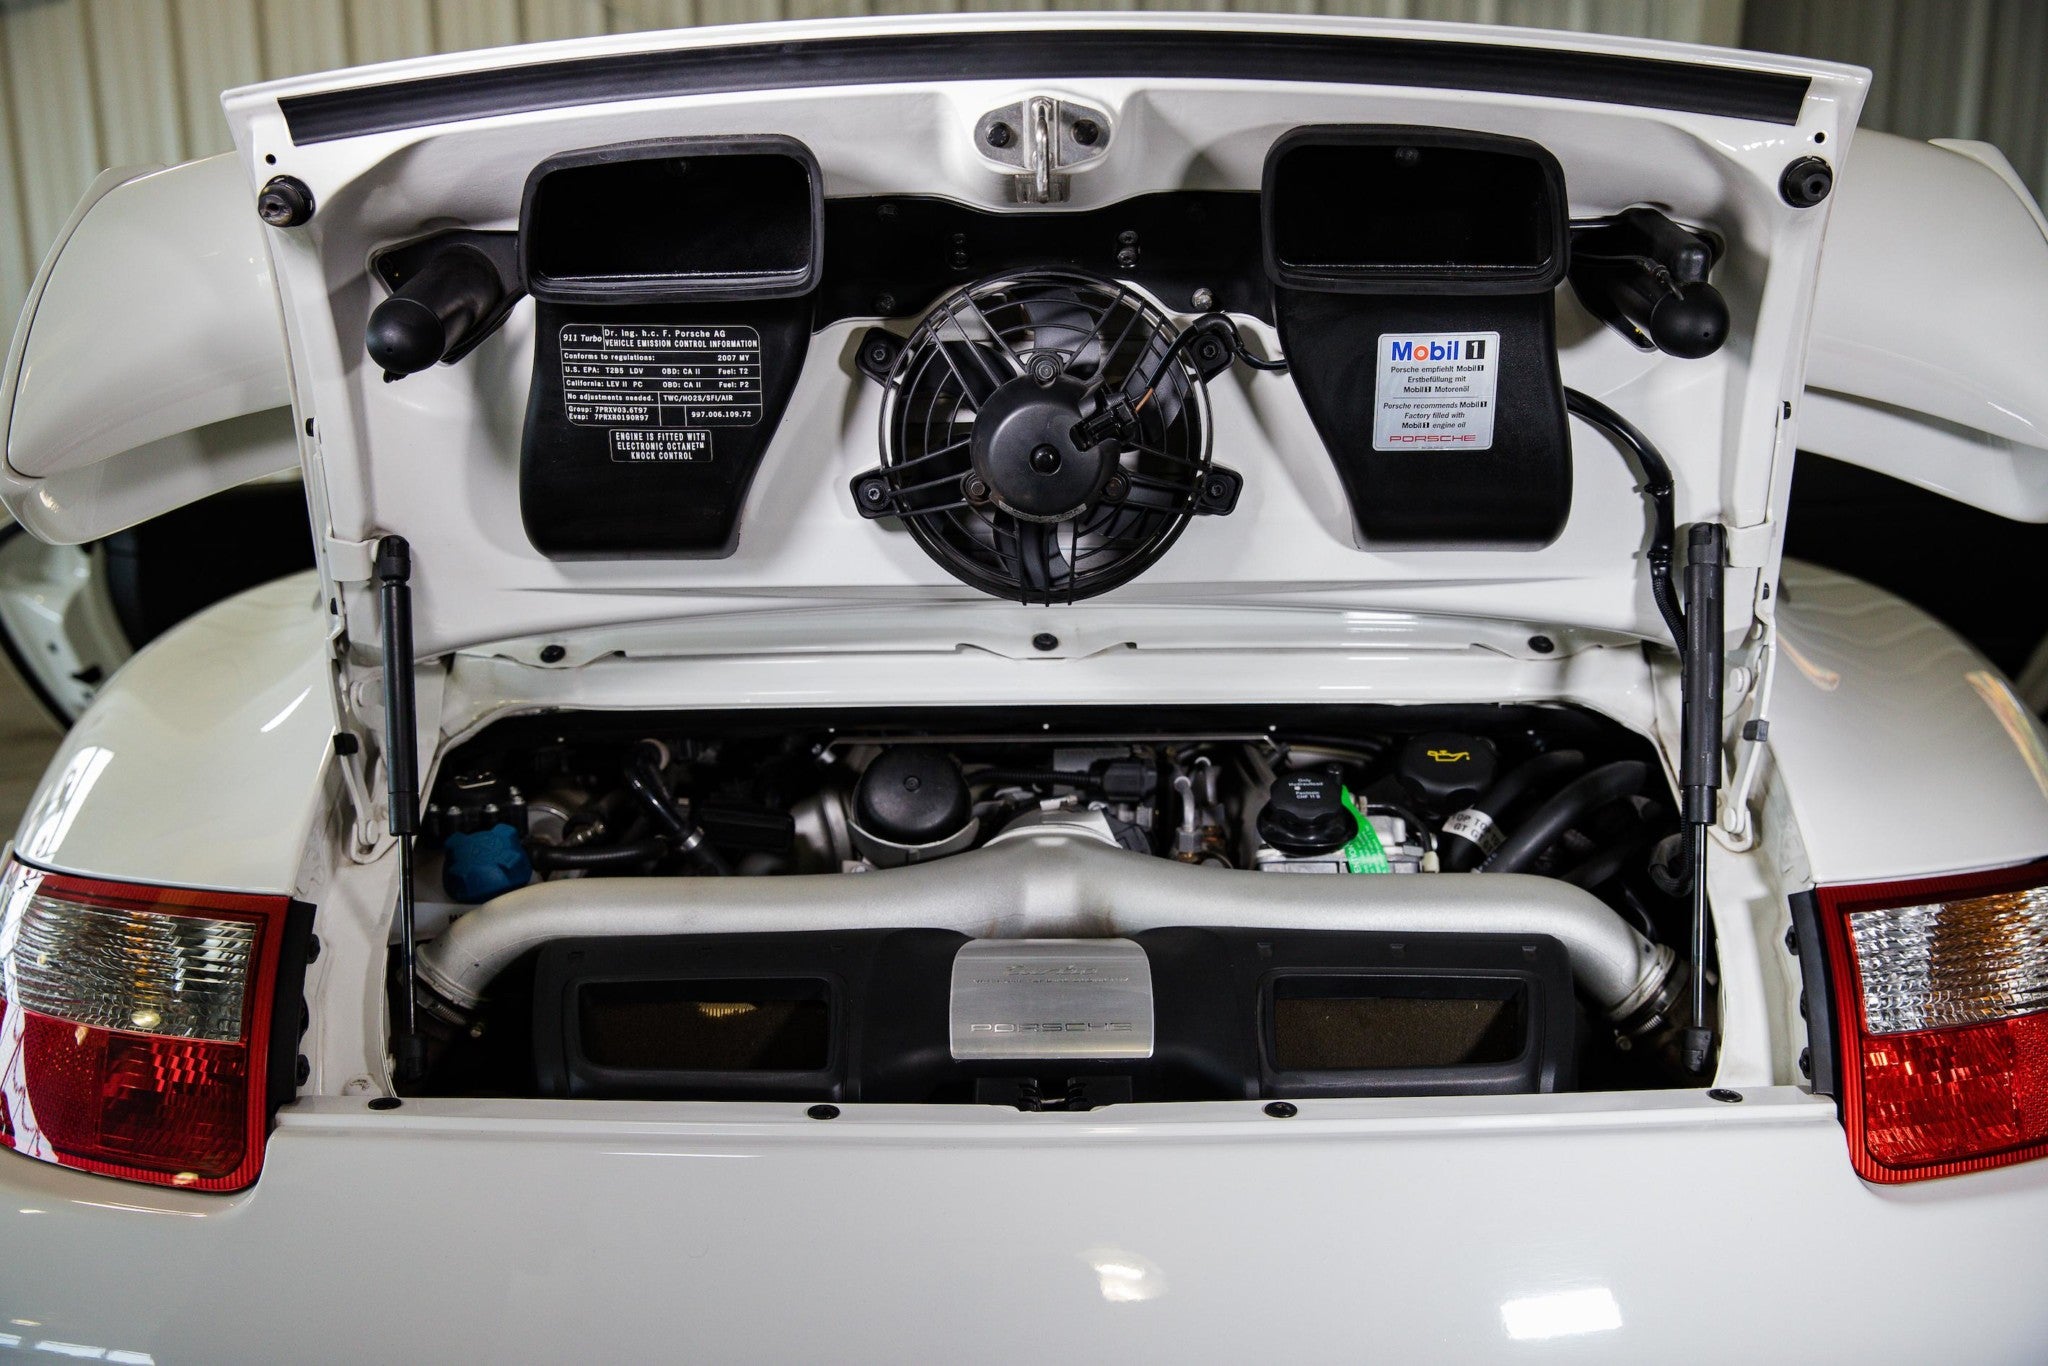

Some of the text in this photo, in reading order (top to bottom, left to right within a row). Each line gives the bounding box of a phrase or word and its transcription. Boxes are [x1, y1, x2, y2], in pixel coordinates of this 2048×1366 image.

[604, 329, 618, 337] Dr.
[621, 329, 638, 338] Ing.
[641, 329, 659, 337] h.c.
[675, 330, 710, 338] Porsche
[714, 330, 726, 338] AG
[563, 334, 602, 342] 911 Turbo
[604, 339, 758, 348] VEHICLE EMISSION CONTROL INFORMATION
[1391, 340, 1459, 361] Mobil
[563, 352, 598, 360] Conforms
[611, 353, 655, 361] regulations:
[606, 380, 620, 388] LEV
[1407, 376, 1453, 384] Erstbefüllung
[579, 393, 622, 401] adjustments
[568, 405, 592, 413] Group:
[1413, 401, 1458, 409] recommends
[1404, 412, 1431, 420] Factory
[1432, 422, 1455, 430] engine
[615, 432, 706, 441] ENGINE IS FITTED WITH
[1389, 435, 1476, 443] PORSCHE
[617, 442, 664, 450] ELECTRONIC
[631, 451, 693, 460] KNOCK CONTROL
[970, 1022, 1133, 1033] PORSCHE
